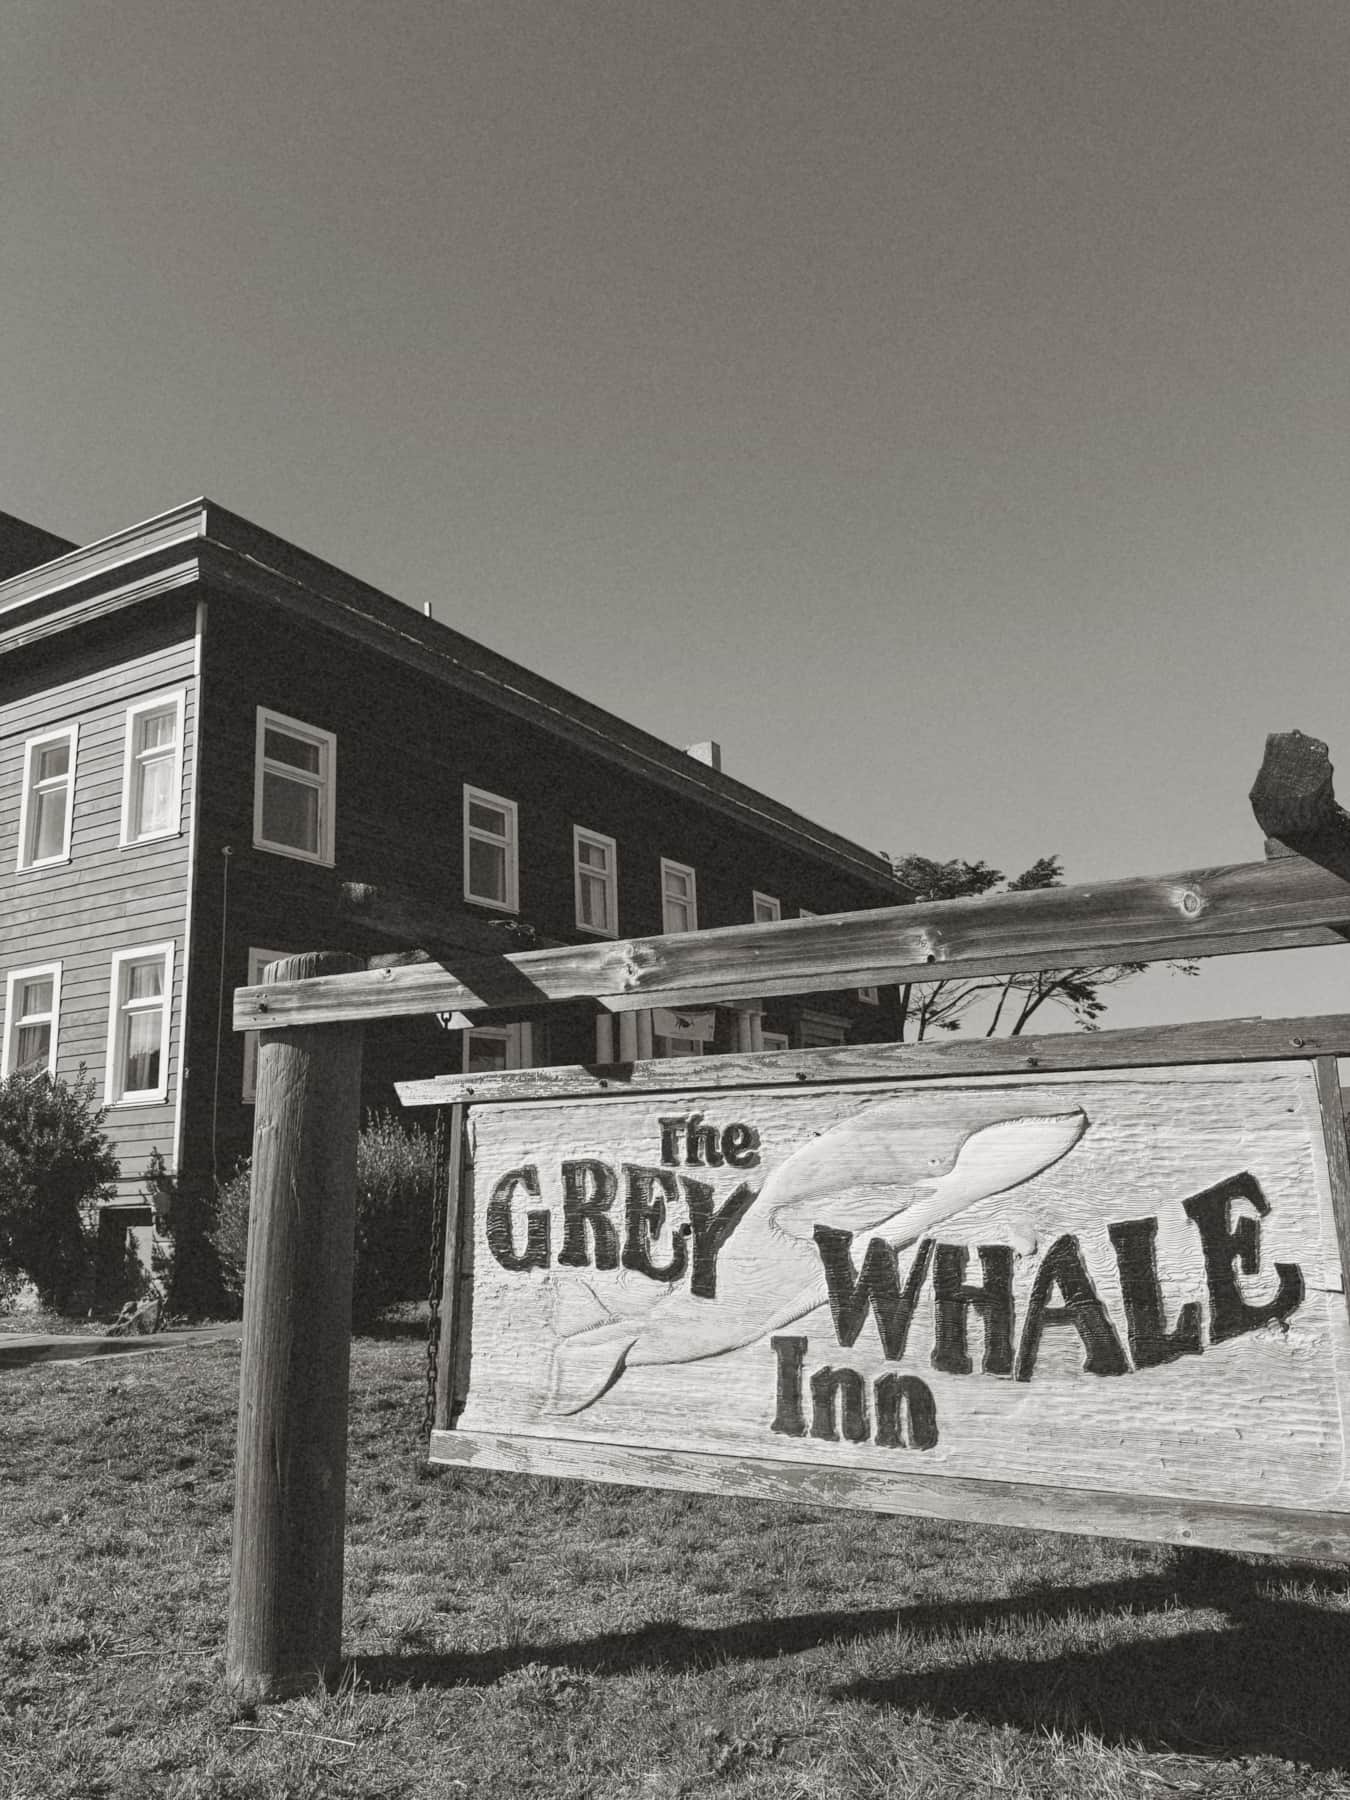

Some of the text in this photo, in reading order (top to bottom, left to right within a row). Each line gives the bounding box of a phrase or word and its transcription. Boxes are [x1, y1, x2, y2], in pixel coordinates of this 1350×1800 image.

[658, 1113, 761, 1169] The
[486, 1158, 762, 1299] GREY
[813, 1171, 1305, 1382] WHALE
[770, 1336, 939, 1450] Inn
